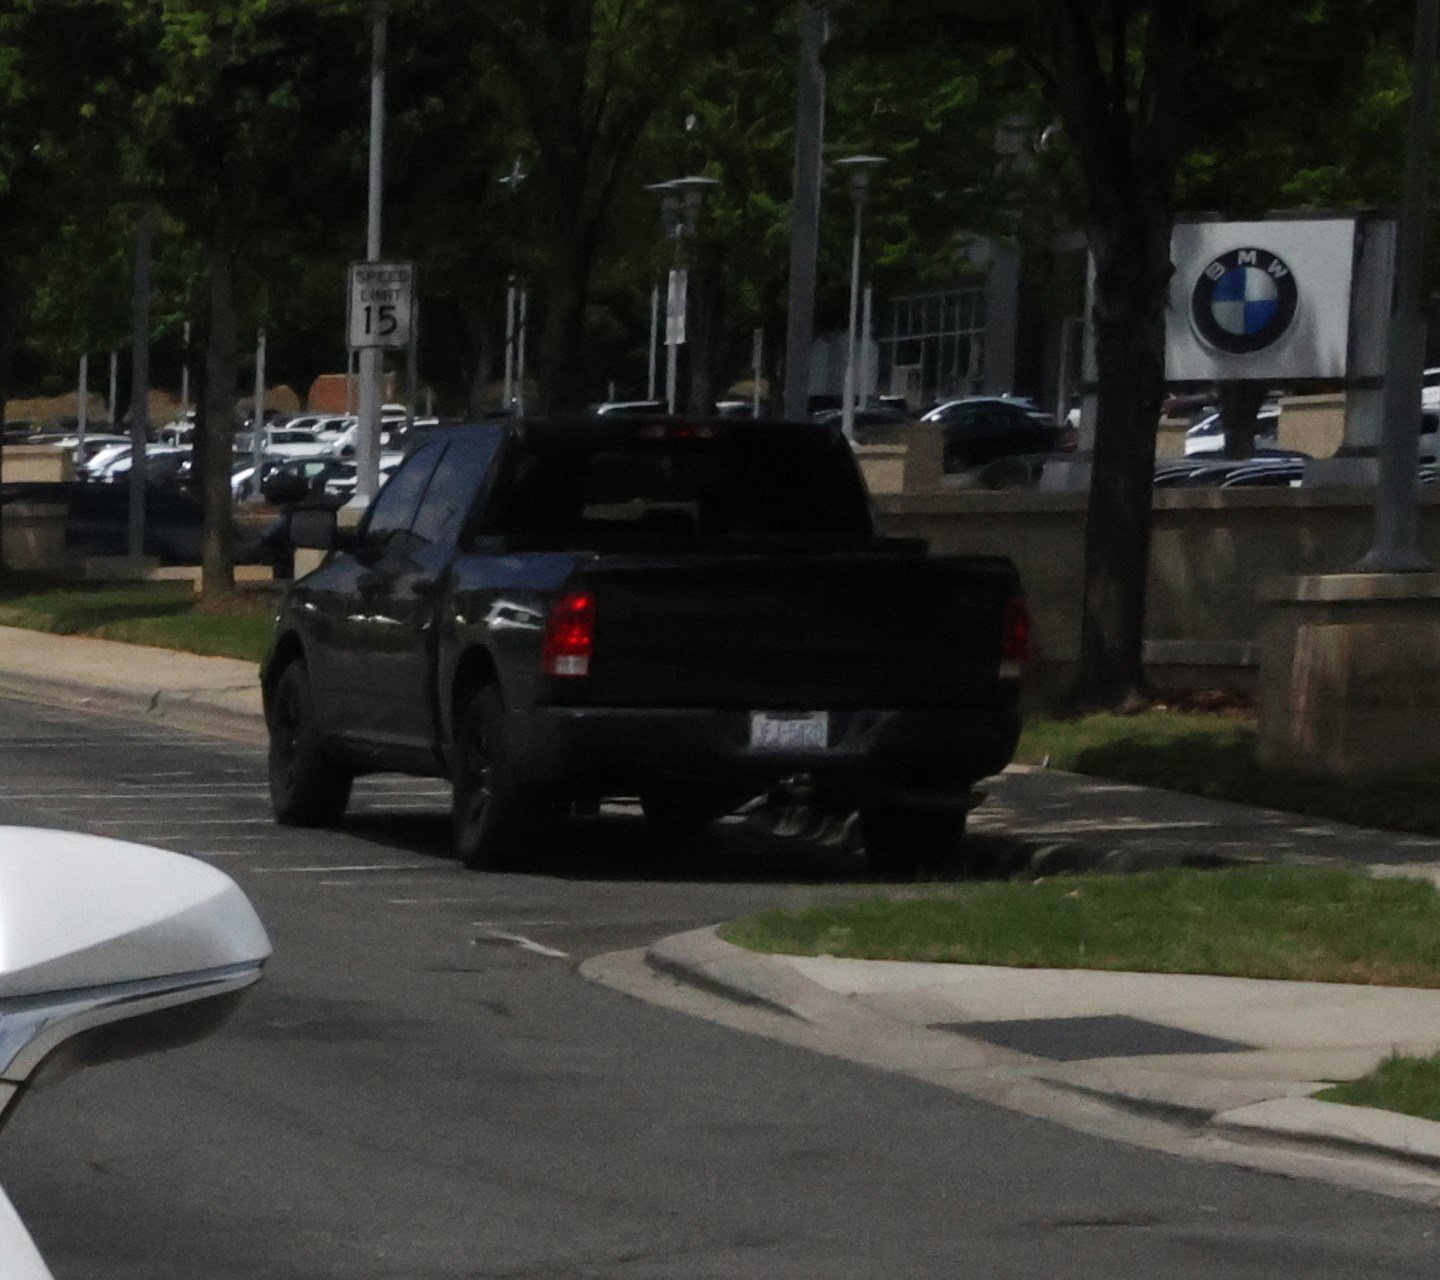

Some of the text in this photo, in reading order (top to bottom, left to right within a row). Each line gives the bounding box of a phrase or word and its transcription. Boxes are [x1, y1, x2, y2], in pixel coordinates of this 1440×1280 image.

[1203, 249, 1288, 282] BMW
[356, 270, 410, 284] SPEED
[360, 289, 400, 302] LIMIT
[364, 305, 398, 336] 15
